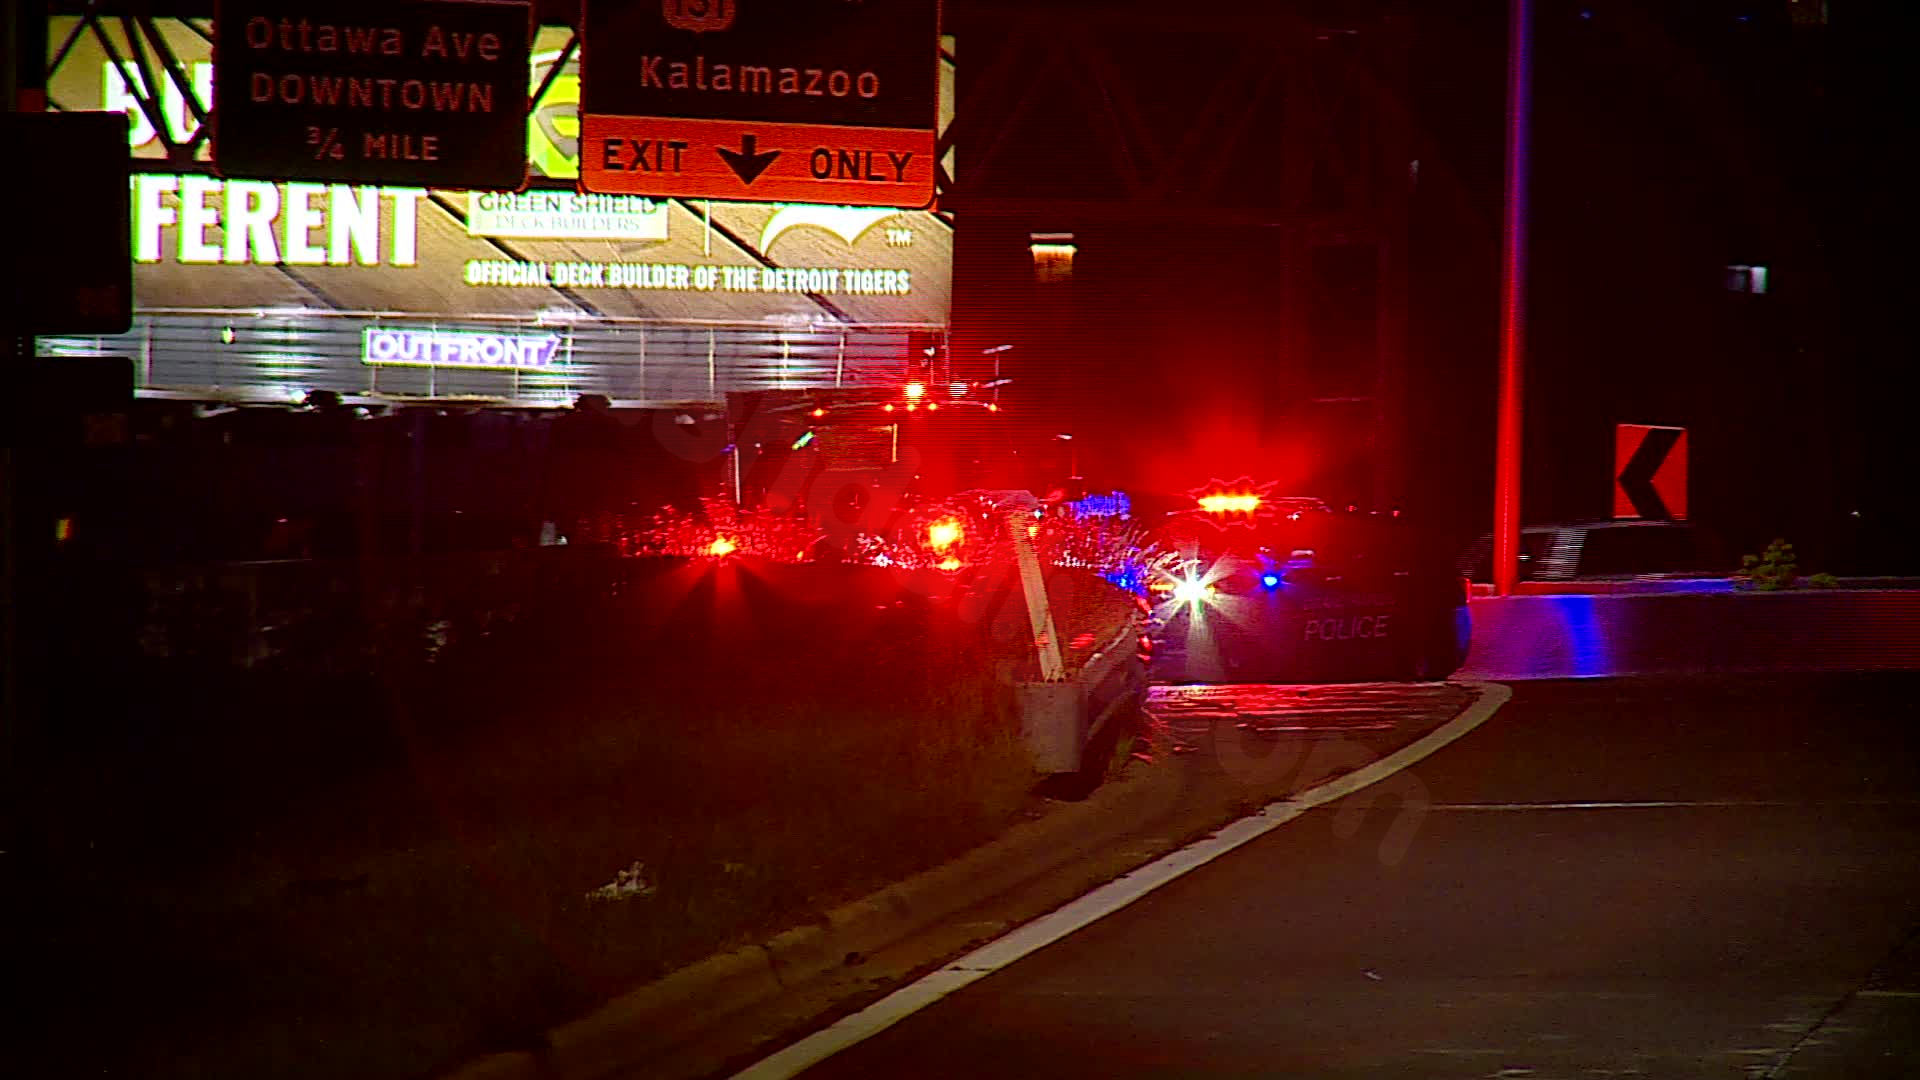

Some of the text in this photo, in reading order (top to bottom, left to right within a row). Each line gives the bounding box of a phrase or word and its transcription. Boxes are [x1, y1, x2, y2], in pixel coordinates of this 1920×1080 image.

[247, 16, 500, 60] Ottawa Ave
[251, 72, 492, 112] DOWNTOWN
[640, 55, 880, 98] Kalamazoo
[362, 131, 440, 161] MILE
[602, 138, 913, 183] EXIT ONLY
[130, 172, 428, 266] FERENT
[478, 192, 656, 214] GREEN SHIELD
[551, 215, 640, 231] BUILDERS
[466, 259, 912, 295] OFFICIAL DECK BUILDER OF THE DETROIT TIGERS
[372, 331, 549, 365] OUTFRONT
[1304, 615, 1390, 641] POLICE
